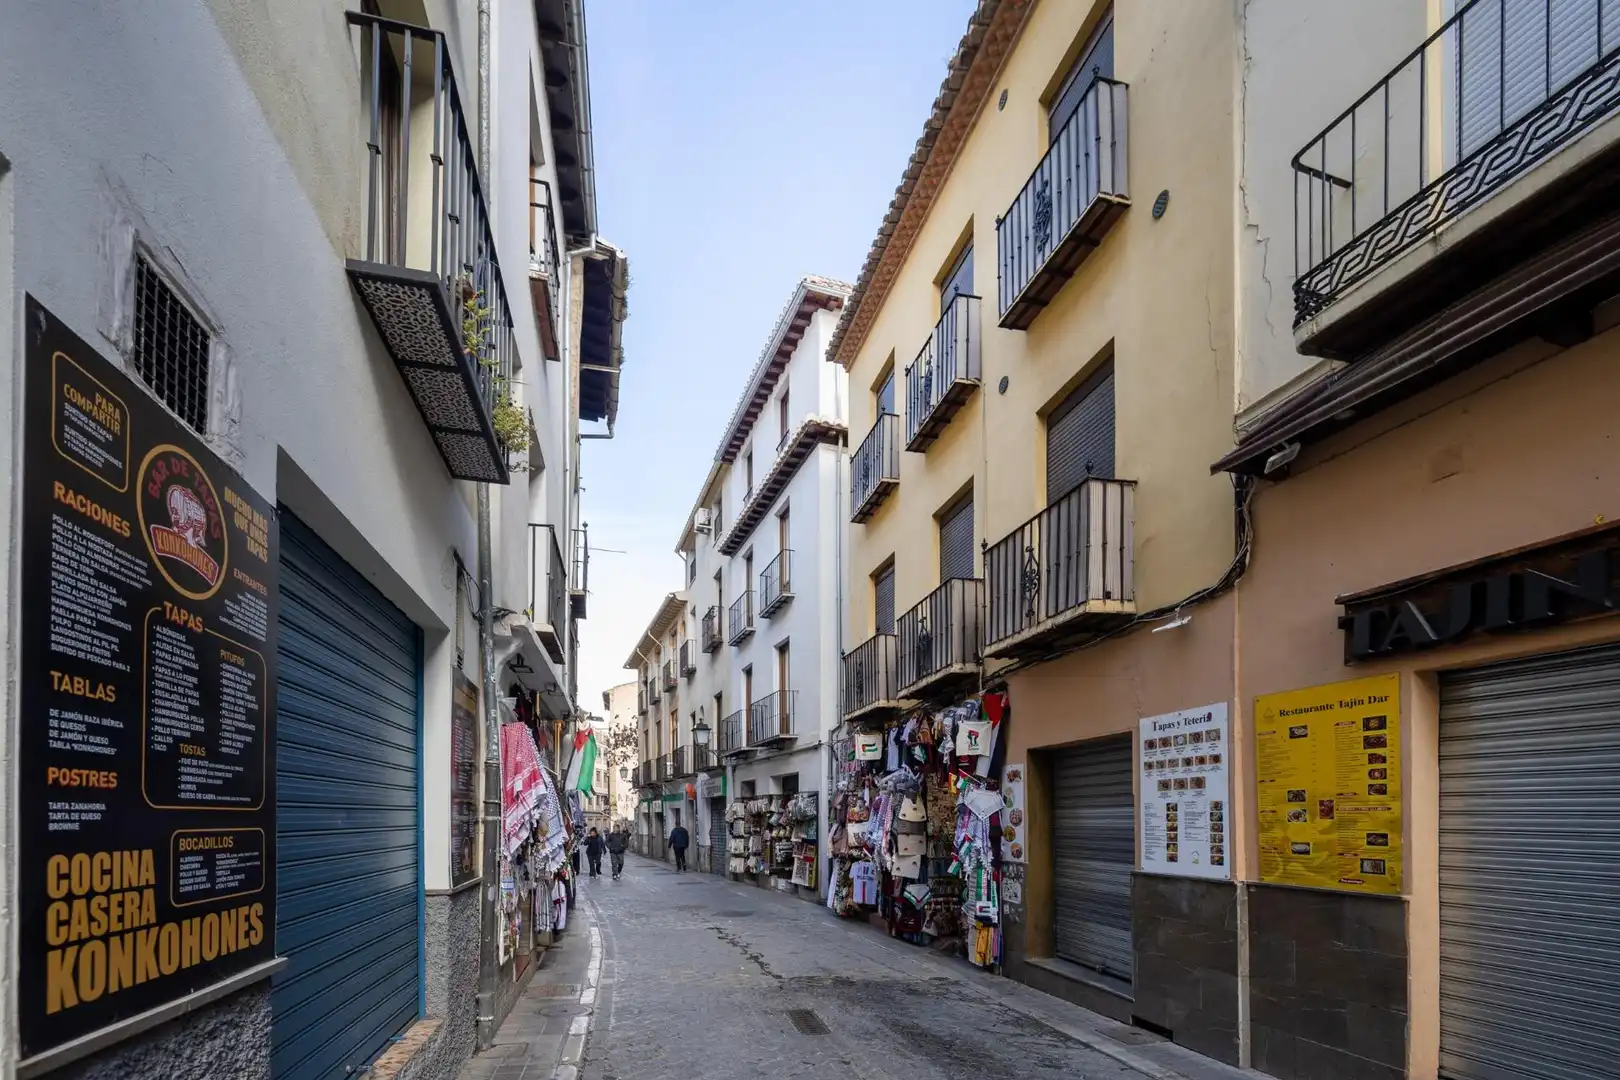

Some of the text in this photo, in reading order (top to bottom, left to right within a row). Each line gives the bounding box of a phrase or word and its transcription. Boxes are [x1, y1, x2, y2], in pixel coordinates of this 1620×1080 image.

[64, 382, 119, 434] COMPARTIR
[96, 392, 119, 421] PARA
[88, 418, 96, 430] DE
[97, 425, 112, 441] TAPAS
[54, 481, 130, 539] RACIONES
[148, 456, 222, 540] BAR DE TAPAS
[224, 485, 251, 520] MUCHO
[52, 514, 114, 551] POLLO AL ROQUEFORT
[52, 524, 71, 539] POLLO
[73, 534, 78, 542] A
[79, 536, 87, 547] LA
[88, 541, 112, 558] MOSTAZA
[234, 511, 267, 547] QUE UNAS
[52, 533, 71, 548] POLLO
[73, 542, 86, 555] CON
[87, 549, 118, 570] ALMENDRAS
[52, 542, 79, 561] TERNERA
[81, 555, 89, 565] EN
[91, 560, 107, 573] SALSA
[156, 529, 214, 580] KONKOHONES
[247, 537, 267, 562] TAPAS
[52, 552, 94, 577] RABO DE TORO
[52, 561, 88, 582] CARRILLADA
[89, 577, 98, 586] EN
[99, 581, 116, 594] SALSA
[52, 571, 75, 586] HUEVOS
[77, 581, 95, 594] ROTOS
[96, 589, 108, 599] CON
[52, 580, 70, 593] PLATO
[233, 568, 266, 595] ENTRANTES
[51, 596, 95, 617] HAMBURGUESA
[52, 605, 74, 618] PAELLA
[76, 614, 91, 624] PARA
[164, 601, 203, 632] TAPAS
[52, 615, 71, 627] PULPO
[51, 625, 119, 652] LANGOSTINOS AL PIL PIL
[51, 634, 90, 651] BOQUERONES
[51, 644, 76, 656] SURTIDO
[77, 651, 86, 659] DE
[87, 654, 111, 666] PESCADO
[112, 661, 125, 670] PARA
[156, 650, 170, 660] PAPAS
[181, 650, 195, 659] SALSA
[220, 650, 244, 666] PITUFOS
[155, 665, 170, 675] PAPAS
[175, 671, 182, 679] LO
[50, 671, 115, 702] TABLAS
[156, 680, 176, 691] TORTILLA
[185, 688, 199, 697] PAPAS
[49, 708, 123, 727] DE JAMÓN RAZA IBÉRICA
[1279, 703, 1335, 717] Restaurante
[1368, 695, 1390, 704] Dar
[49, 719, 85, 731] DE QUESOS
[49, 729, 59, 737] DE
[60, 729, 82, 740] JAMÓN
[89, 736, 108, 744] QUESO
[154, 725, 169, 733] POLLO
[1152, 721, 1175, 731] Tapas
[49, 740, 70, 749] TABLA
[154, 735, 172, 743] CALLOS
[179, 744, 205, 755] TOSTAS
[48, 767, 116, 787] POSTRES
[179, 836, 233, 850] BOCADILLOS
[48, 850, 154, 898] COCINA
[47, 888, 155, 945] CASERA
[47, 902, 263, 1014] KONKOHONES
